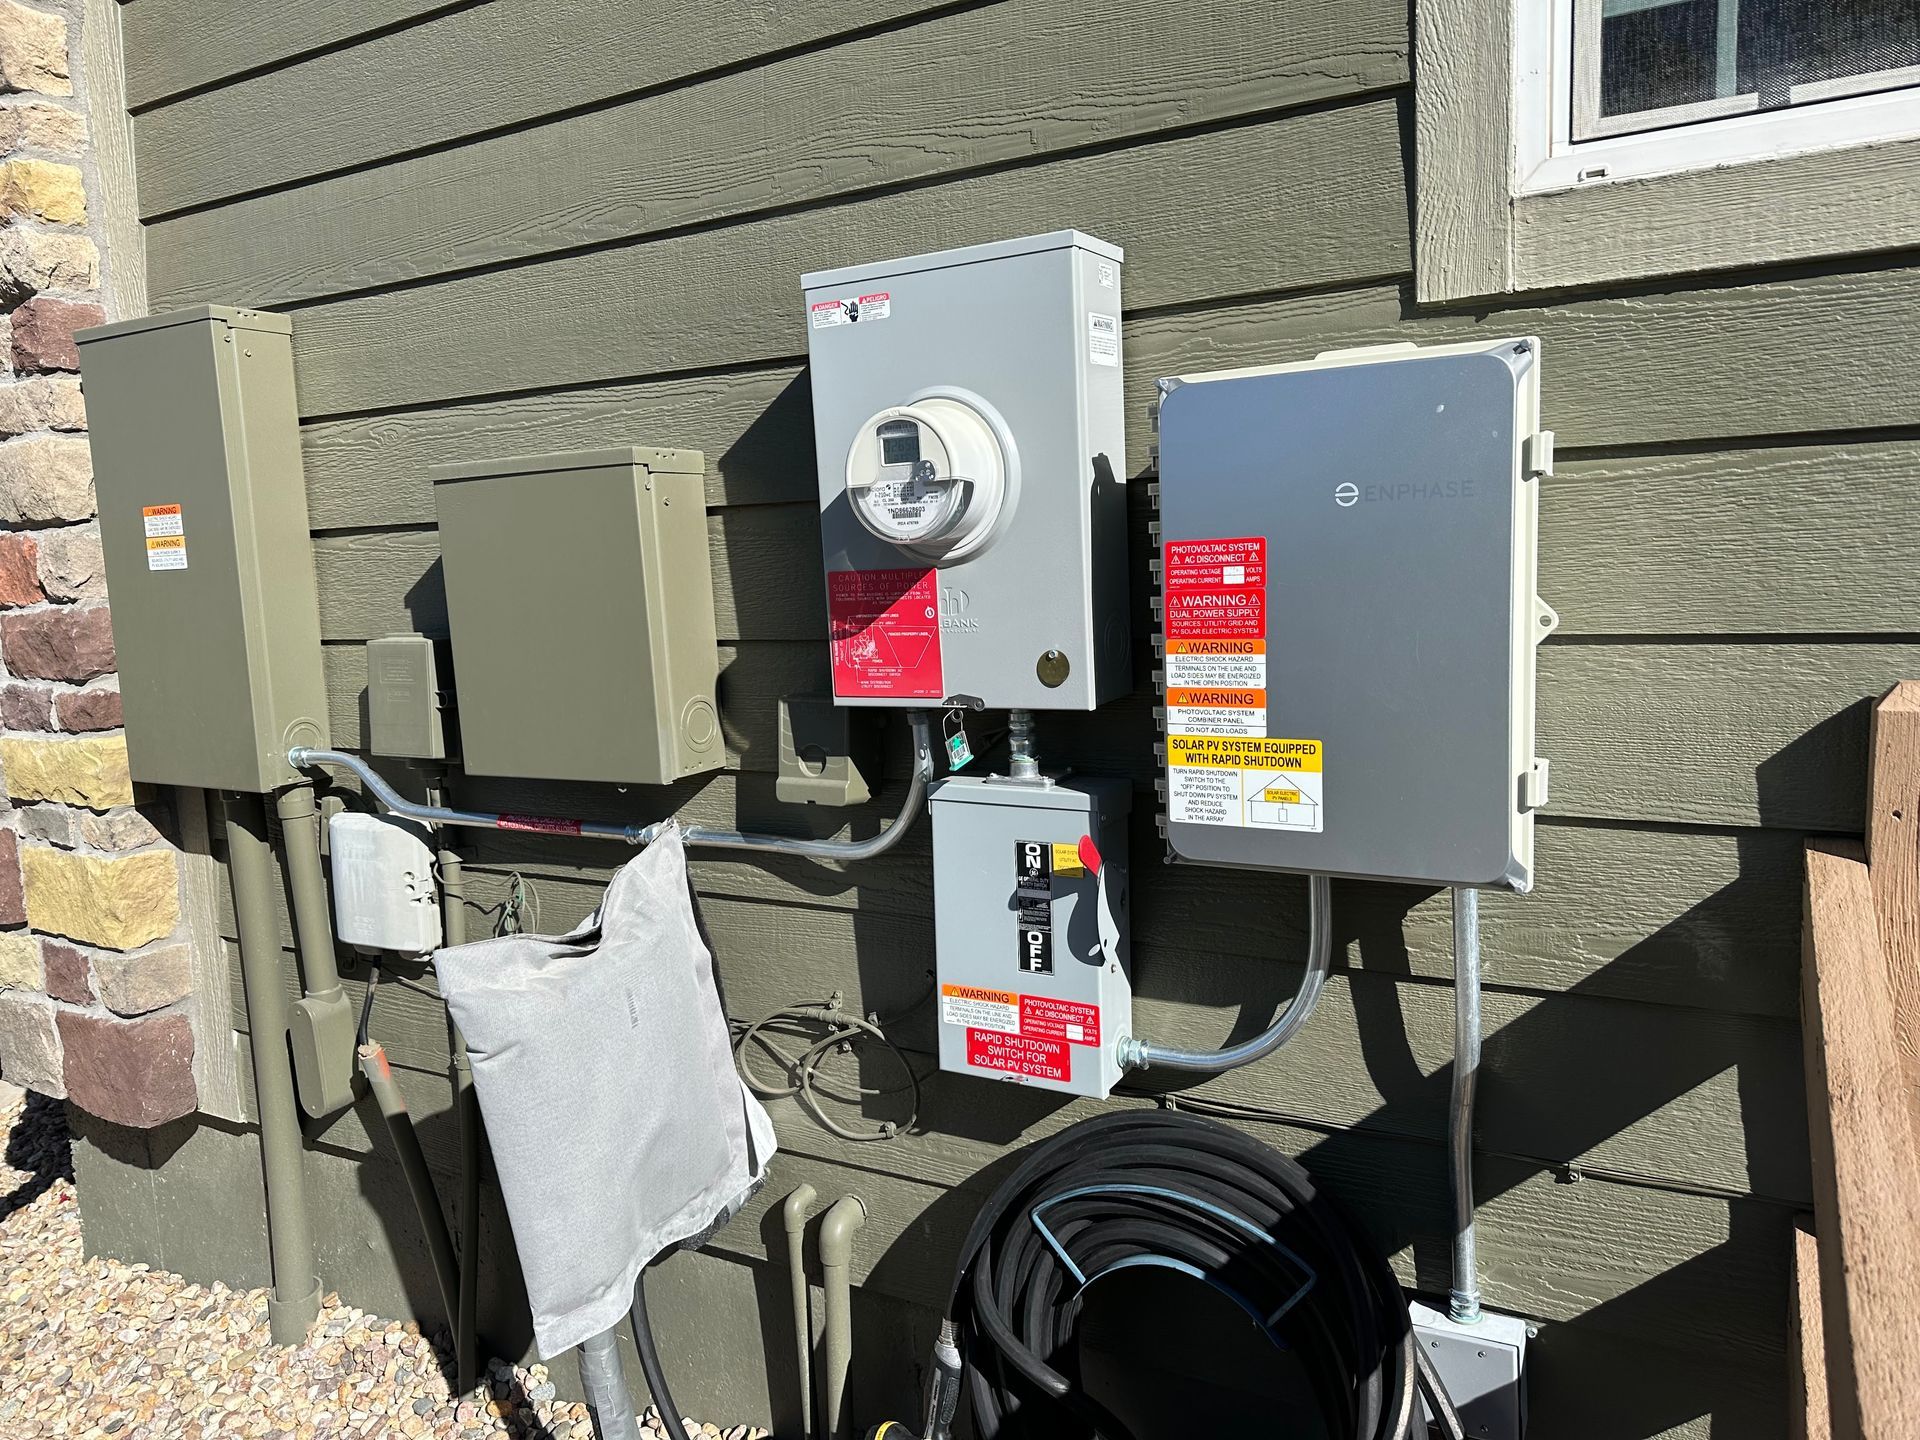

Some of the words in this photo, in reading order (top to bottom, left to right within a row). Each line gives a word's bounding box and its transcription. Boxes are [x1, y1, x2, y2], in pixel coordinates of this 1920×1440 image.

[1365, 480, 1474, 502] ENPHASE
[1172, 544, 1226, 553] PHOTOVOLTAIC
[1197, 554, 1245, 563] DISCONNECT
[882, 571, 923, 580] MULTIPLE
[833, 583, 873, 591] SOURCES
[1182, 595, 1246, 606] WARNING
[1170, 610, 1191, 618] DUAL
[1193, 609, 1224, 618] POWER
[1227, 609, 1260, 617] SUPPLY
[1189, 642, 1253, 653] WARNING
[1189, 693, 1254, 704] WARNING
[1173, 739, 1204, 750] SOLAR
[1207, 741, 1219, 750] PV
[1222, 741, 1262, 753] SYSTEM
[1264, 743, 1316, 754] EQUIPPED
[1186, 753, 1209, 764] WITH
[1212, 754, 1241, 765] RAPID
[1244, 756, 1302, 768] SHUTDOWN
[1025, 844, 1041, 868] ON
[1027, 931, 1043, 971] OFF
[960, 988, 1009, 1004] WARNING
[950, 998, 971, 1006] ELECTRIC
[1024, 999, 1069, 1012] PHOTOVOLTAIC
[1070, 1005, 1094, 1015] SYSTEM
[950, 1006, 974, 1014] TERMINALS
[990, 1017, 1015, 1025] ENERGIZED
[1045, 1010, 1083, 1022] DISCONNECT
[984, 1022, 1006, 1030] POSITION
[974, 1032, 1002, 1044] RAPID
[1005, 1036, 1060, 1054] SHUTDOWN
[988, 1046, 1024, 1059] SWITCH
[1027, 1051, 1046, 1063] FOR
[975, 1054, 1005, 1069] SOLAR
[1008, 1058, 1020, 1070] PV
[1022, 1061, 1061, 1078] SYSTEM
